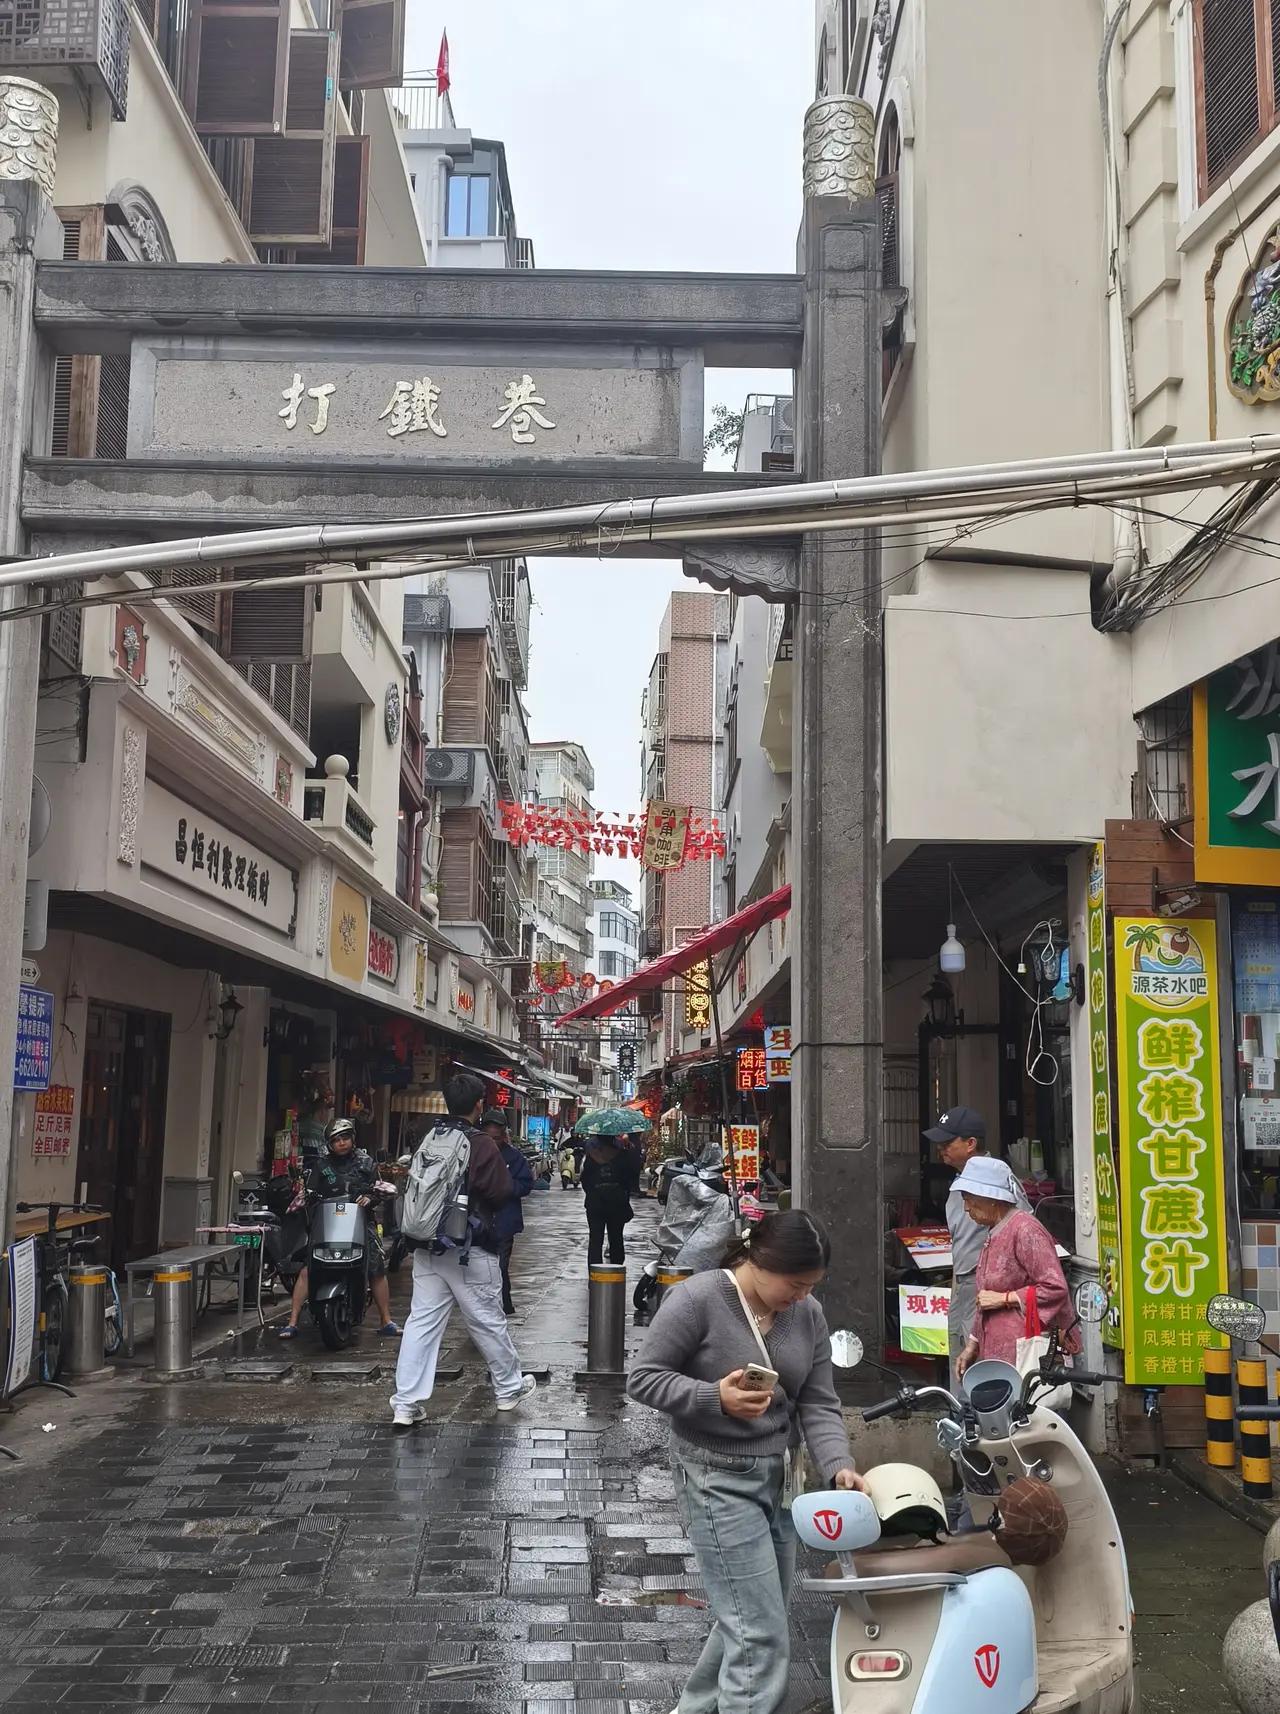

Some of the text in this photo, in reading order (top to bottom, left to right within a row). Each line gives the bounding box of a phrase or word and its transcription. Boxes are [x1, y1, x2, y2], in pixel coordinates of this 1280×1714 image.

[278, 373, 557, 444] 打鐵巷
[1132, 975, 1207, 996] 源茶水吧
[1140, 1020, 1206, 1293] 鲜榨甘蔗汁
[1143, 1330, 1211, 1347] 凤梨甘蔗
